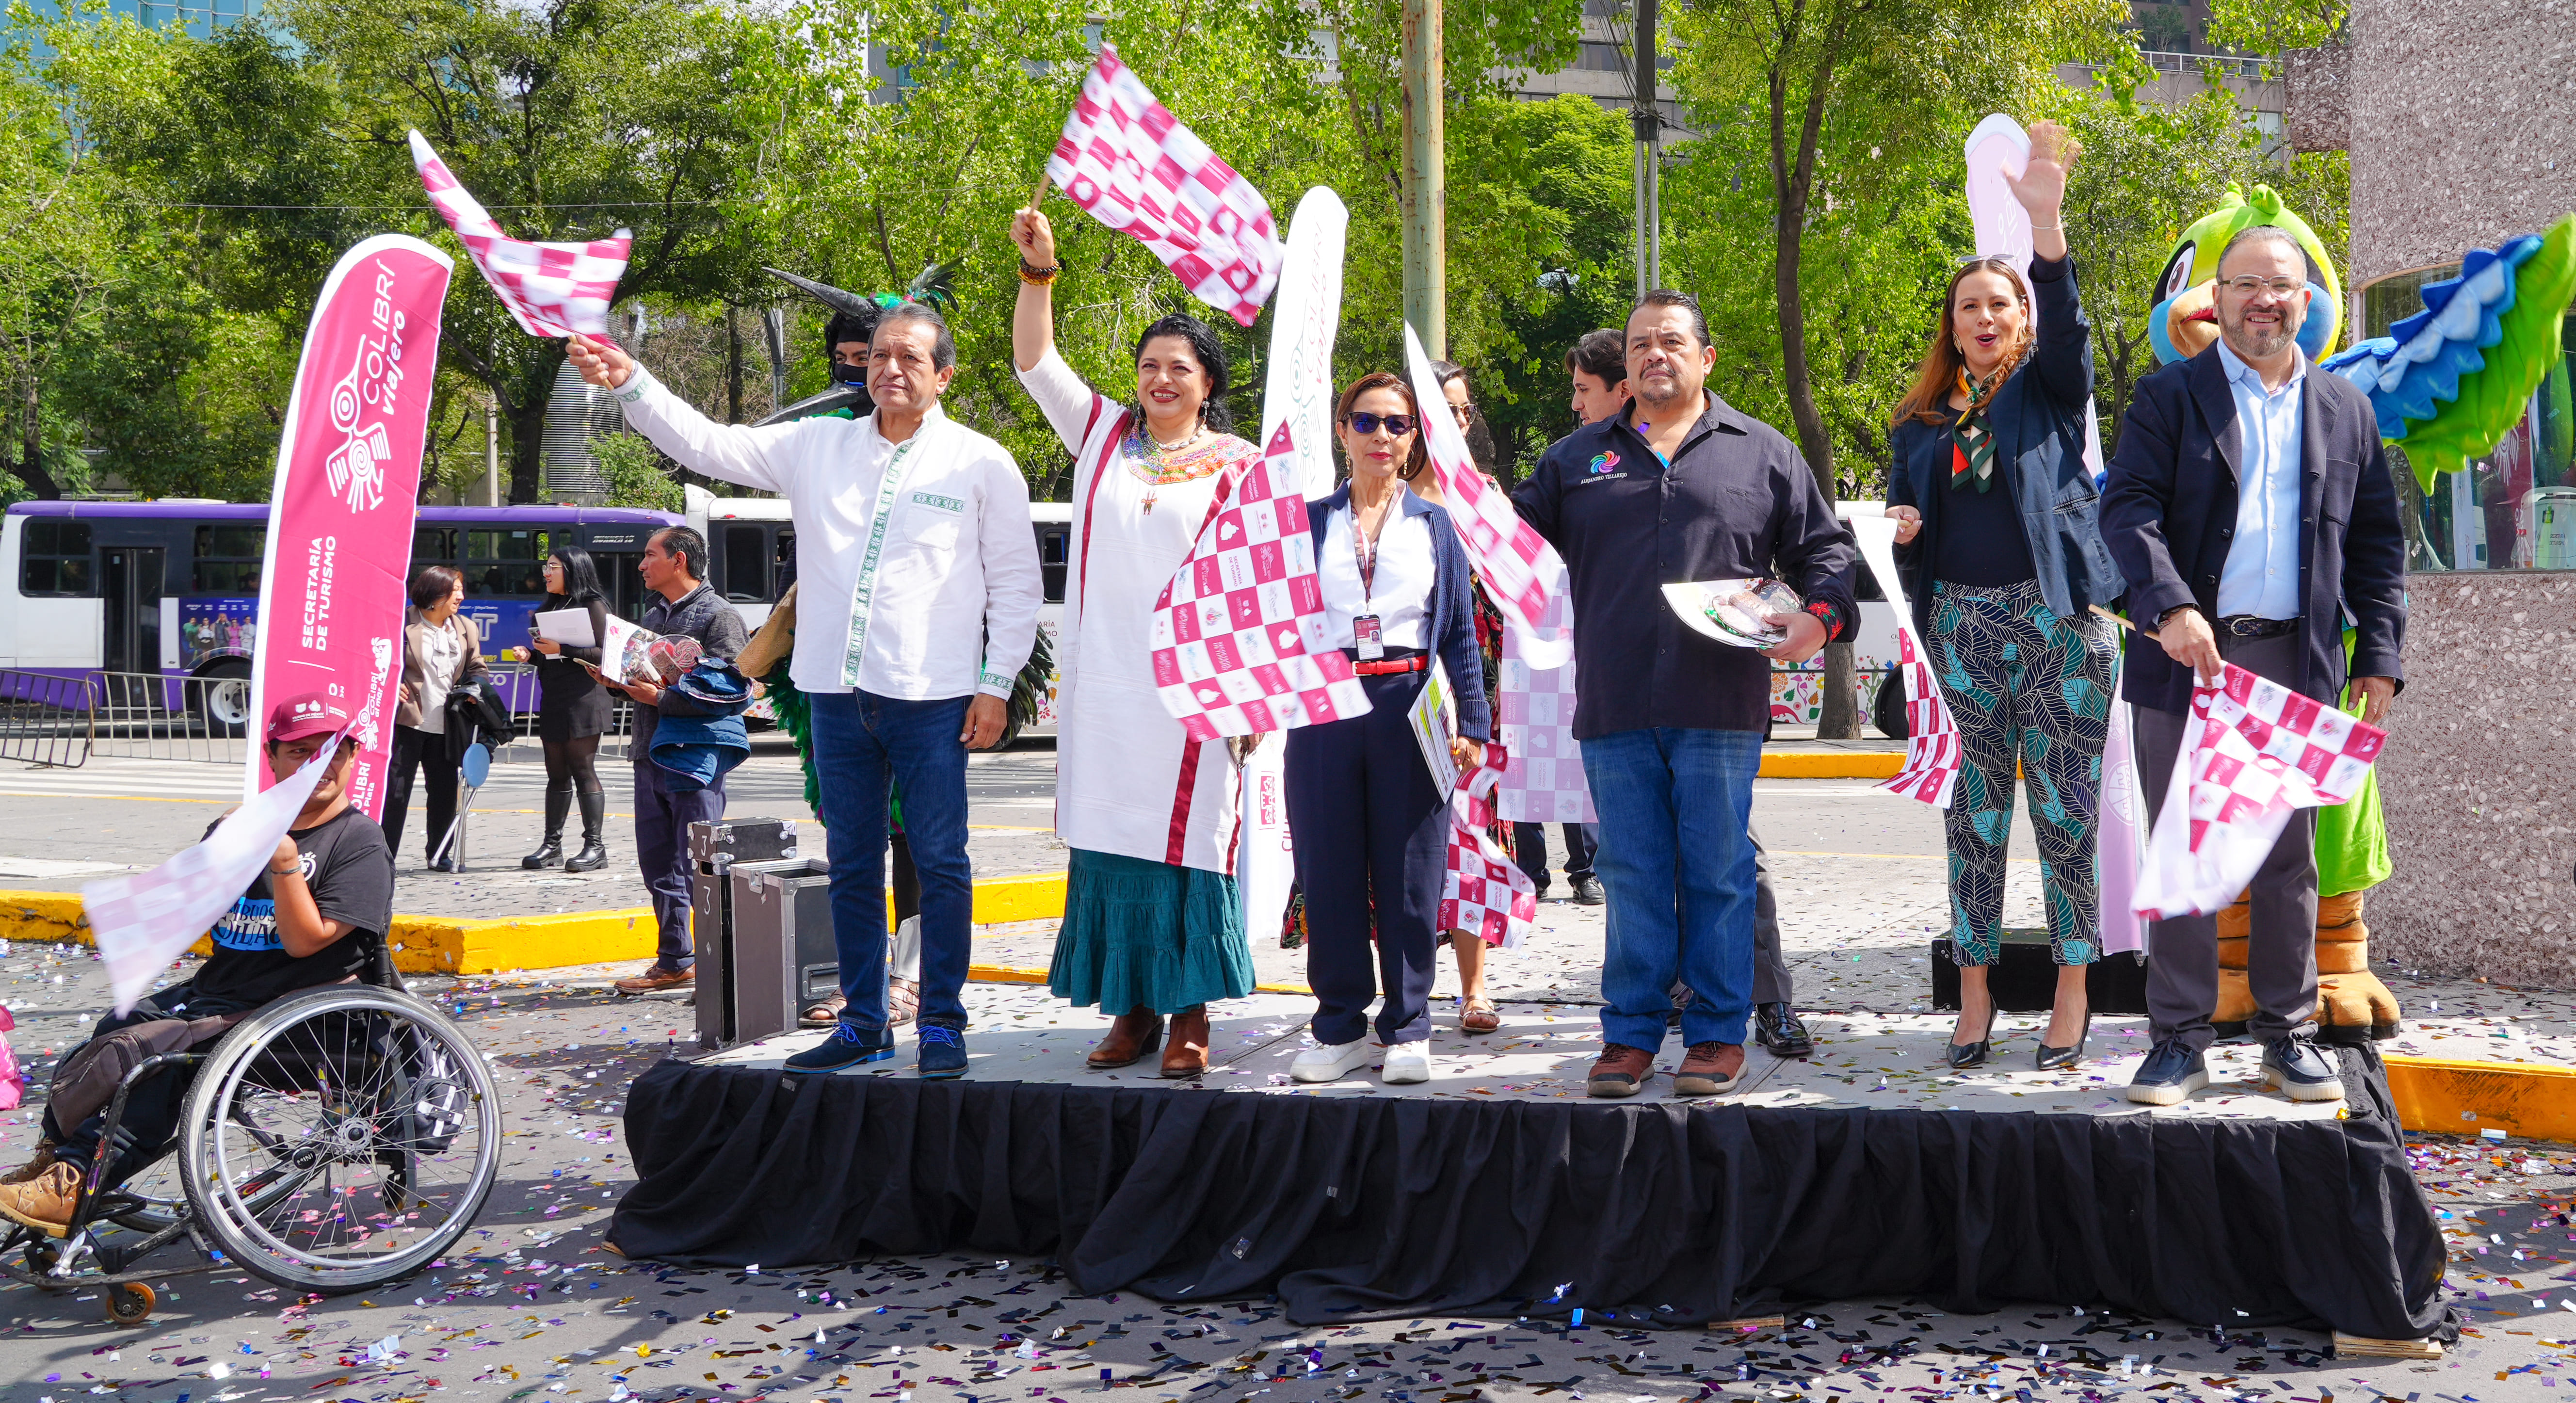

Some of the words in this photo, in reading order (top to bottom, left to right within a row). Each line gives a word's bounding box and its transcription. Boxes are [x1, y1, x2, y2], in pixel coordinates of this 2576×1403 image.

[363, 258, 395, 404] COLIBRÍ
[382, 310, 406, 415] viajero
[1580, 475, 1604, 484] ALEJANDRO
[319, 536, 336, 624] TURISMO
[1233, 556, 1243, 584] SECRETARÍA
[302, 537, 322, 648] SECRETARÍA
[316, 628, 327, 651] DE
[369, 671, 379, 716] COLIBRÍ
[375, 687, 384, 705] mar
[374, 707, 380, 718] al
[350, 760, 371, 810] OLIBRÍ
[365, 782, 375, 806] Plata
[703, 886, 711, 915] 3
[296, 1153, 314, 1166] MINI
